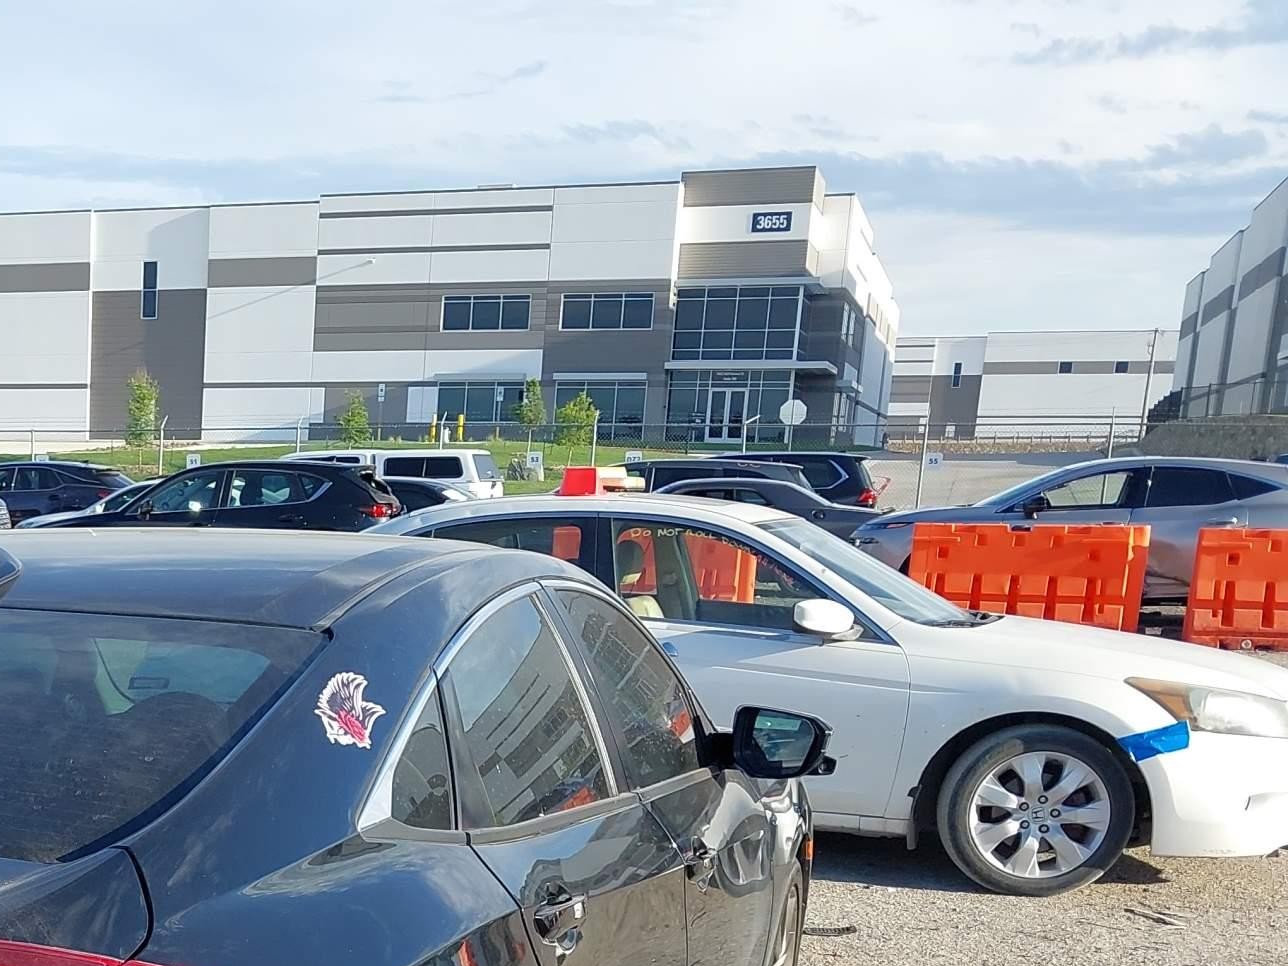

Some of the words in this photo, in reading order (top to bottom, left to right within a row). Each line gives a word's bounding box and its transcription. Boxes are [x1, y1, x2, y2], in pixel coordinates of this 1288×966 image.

[756, 214, 788, 229] 3655
[631, 527, 652, 539] DO
[657, 528, 685, 538] NOT
